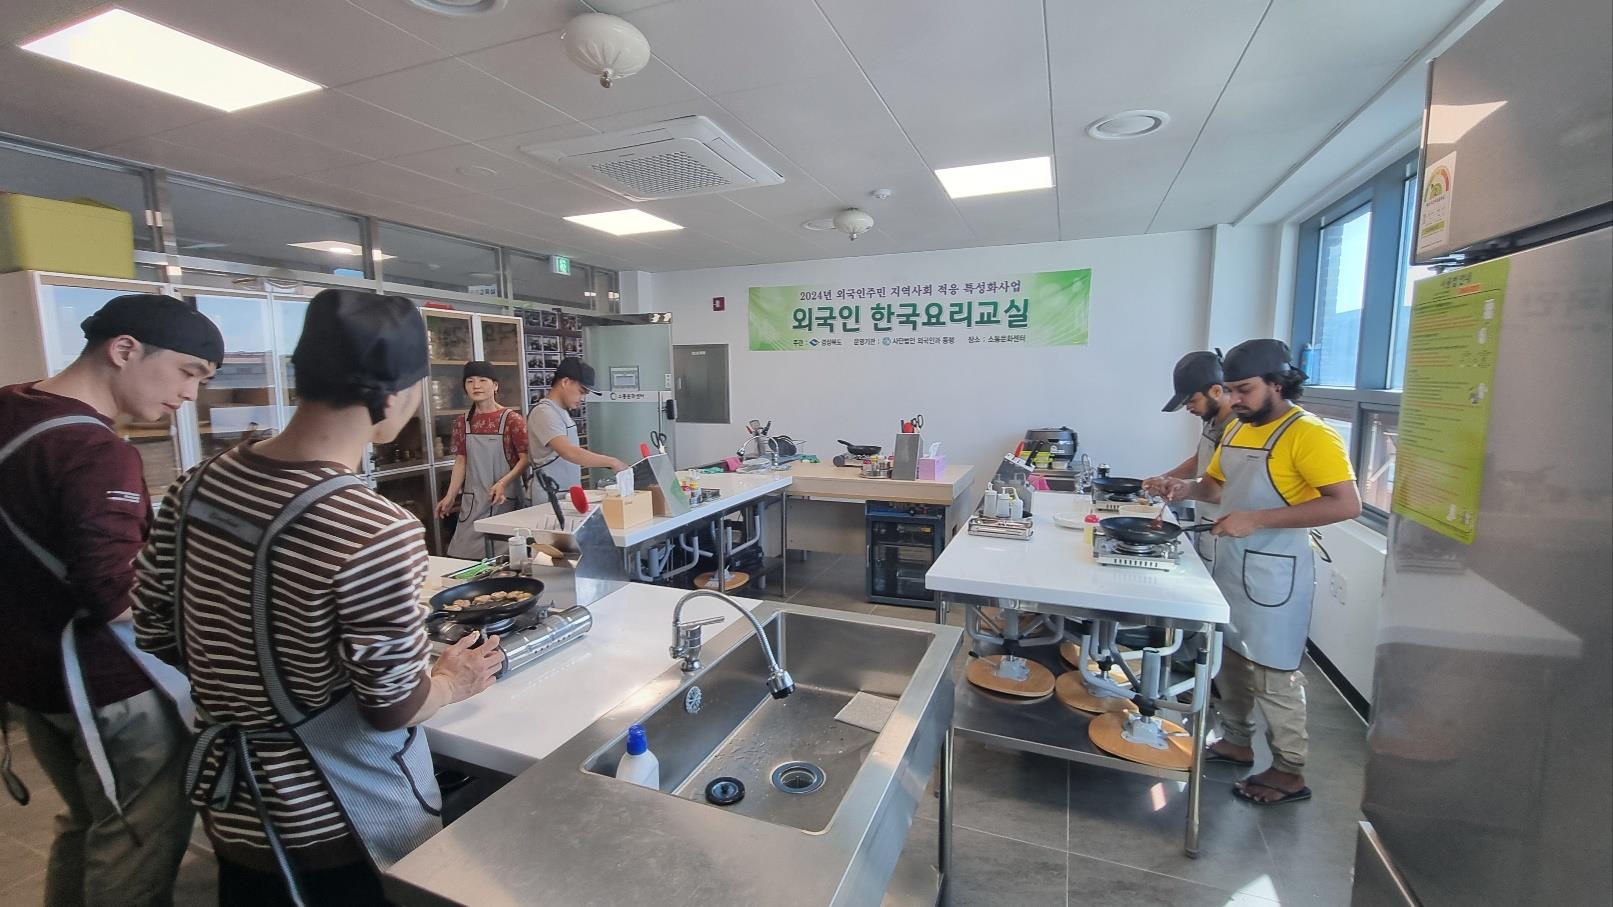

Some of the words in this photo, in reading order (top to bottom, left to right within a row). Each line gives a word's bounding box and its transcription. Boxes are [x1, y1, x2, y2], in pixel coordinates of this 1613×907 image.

[800, 290, 833, 300] 2024년
[836, 287, 886, 299] 외국인주민
[890, 284, 933, 298] 지역사회
[938, 283, 959, 295] 적응
[963, 280, 1021, 294] 특성화사업
[792, 305, 861, 333] 외국인
[870, 299, 1029, 331] 한국요리교실
[821, 338, 843, 347] 경상북도
[892, 336, 916, 345] 사단법인
[967, 336, 981, 344] 장소
